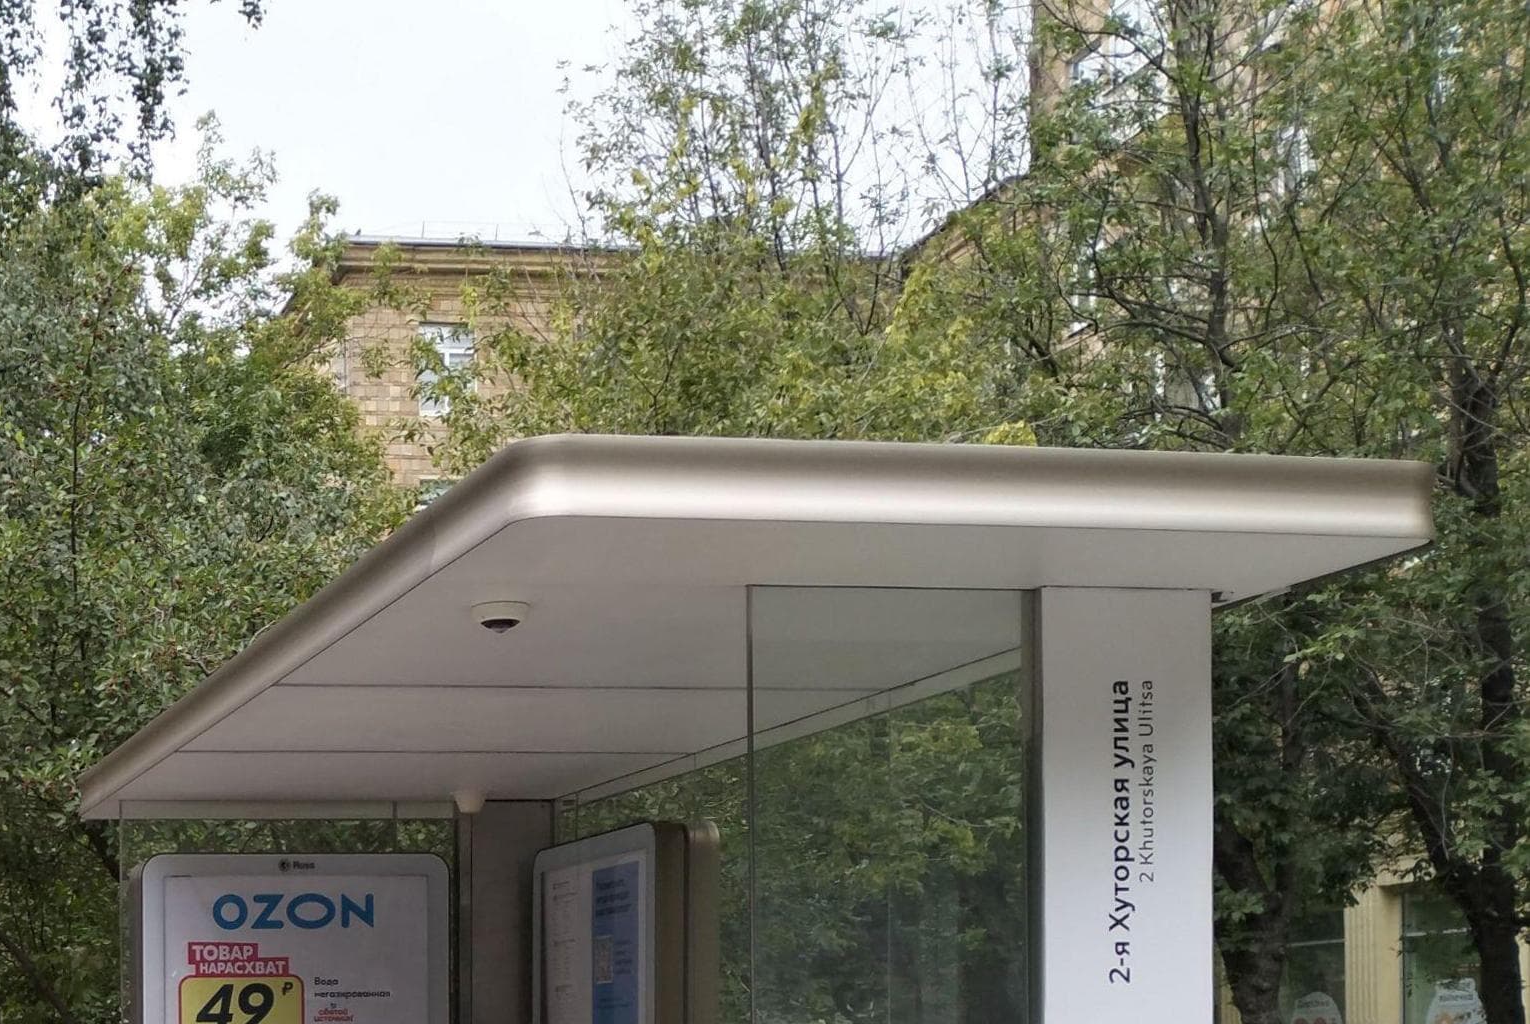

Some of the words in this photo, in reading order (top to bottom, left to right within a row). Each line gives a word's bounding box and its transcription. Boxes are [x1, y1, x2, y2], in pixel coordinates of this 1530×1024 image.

[1112, 680, 1135, 769] улица
[1137, 680, 1154, 737] Ulitsa
[1138, 743, 1157, 865] Khutorskaya
[1108, 777, 1135, 932] Хуторская
[1139, 871, 1154, 882] 2
[212, 893, 375, 931] OZON
[191, 944, 254, 961] ТОВАР
[199, 961, 287, 975] НАРАСХВАТ
[1109, 941, 1131, 984] 2-я
[314, 977, 339, 987] Вода
